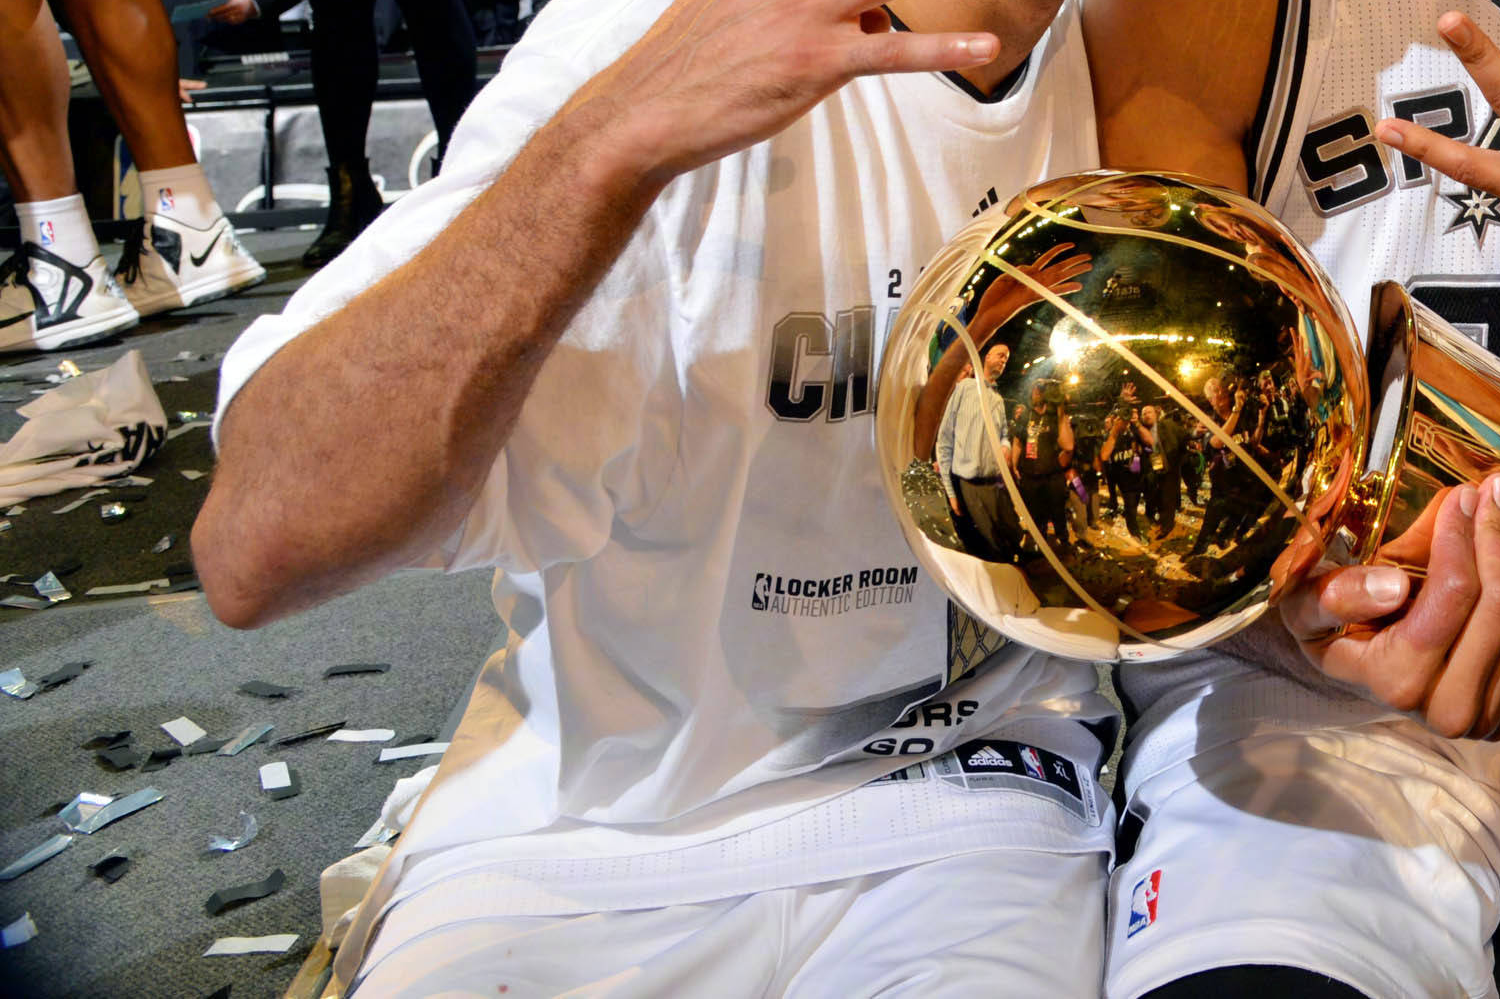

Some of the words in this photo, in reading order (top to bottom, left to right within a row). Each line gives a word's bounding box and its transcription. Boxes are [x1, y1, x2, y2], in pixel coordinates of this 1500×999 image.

[775, 574, 853, 599] LOCKER
[859, 566, 918, 589] ROOM
[770, 593, 851, 618] AUTHENTIC
[855, 585, 915, 610] EDITION
[967, 758, 1014, 768] adidas
[1052, 763, 1072, 782] XL
